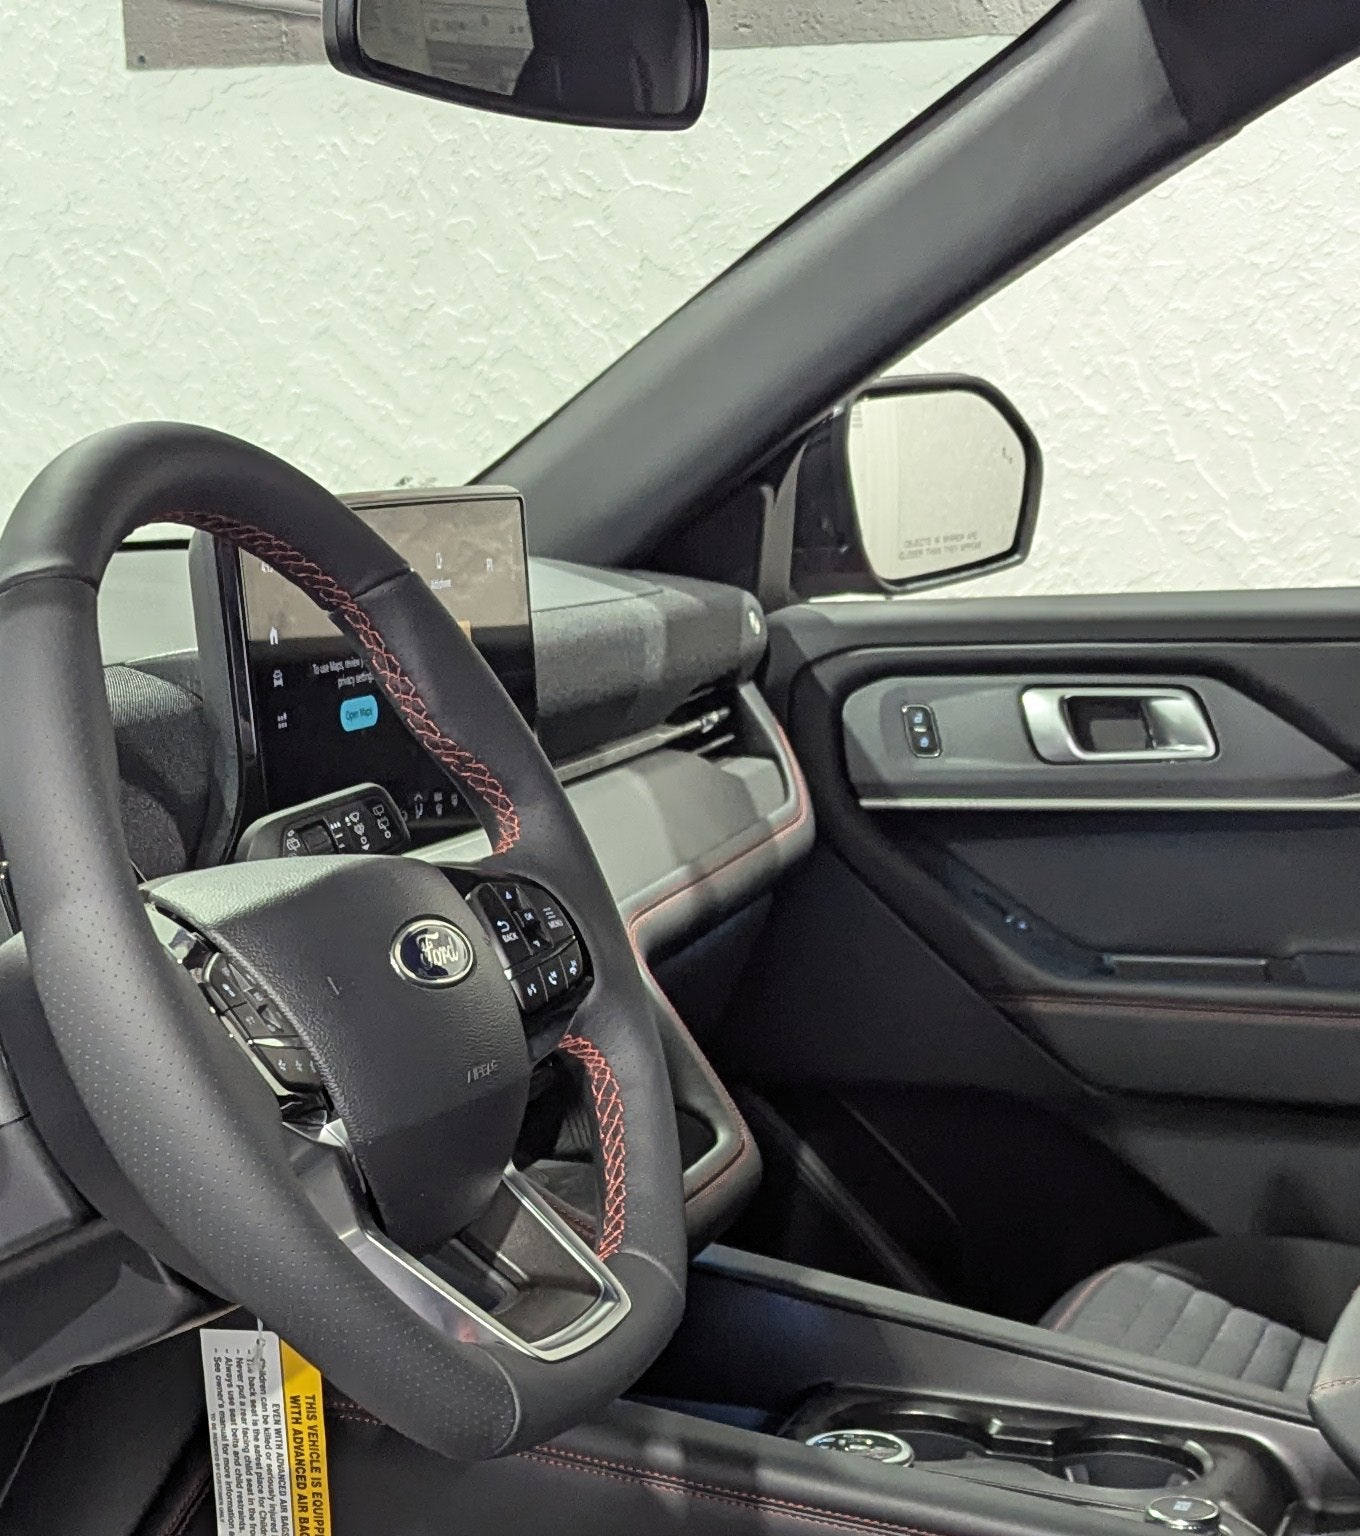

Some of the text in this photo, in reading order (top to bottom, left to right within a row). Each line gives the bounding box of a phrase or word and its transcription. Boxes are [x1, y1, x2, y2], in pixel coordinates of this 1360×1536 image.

[547, 919, 564, 930] MENU
[501, 931, 519, 943] BACK
[415, 931, 459, 970] Ford
[214, 1356, 222, 1373] See
[224, 1356, 233, 1389] Always
[236, 1357, 244, 1383] Never
[236, 1384, 246, 1400] put
[248, 1376, 257, 1398] back
[227, 1390, 235, 1407] use
[250, 1399, 258, 1417] seat
[260, 1397, 268, 1413] can
[304, 1394, 318, 1421] THIS
[229, 1408, 237, 1426] seat
[262, 1414, 270, 1425] be
[271, 1403, 282, 1426] EVEN
[289, 1395, 302, 1425] WITH
[218, 1410, 229, 1442] manual
[251, 1418, 258, 1427] is
[242, 1427, 250, 1454] facing
[252, 1428, 260, 1443] the
[263, 1427, 272, 1450] killed
[274, 1428, 283, 1450] WITH
[221, 1443, 229, 1456] for
[232, 1450, 241, 1467] and
[292, 1428, 307, 1491] ADVANCED
[307, 1424, 322, 1474] VEHICLE
[223, 1457, 231, 1479] more
[244, 1454, 253, 1477] child
[276, 1452, 287, 1497] ADVANCED
[246, 1478, 254, 1496] seat
[254, 1471, 264, 1495] place
[266, 1463, 276, 1501] seriously
[311, 1477, 322, 1488] IS
[225, 1480, 235, 1530] information
[248, 1497, 255, 1506] in
[258, 1496, 266, 1509] for
[279, 1498, 288, 1514] AIR
[297, 1493, 308, 1513] AIR
[248, 1507, 256, 1522] the
[269, 1503, 278, 1533] injured
